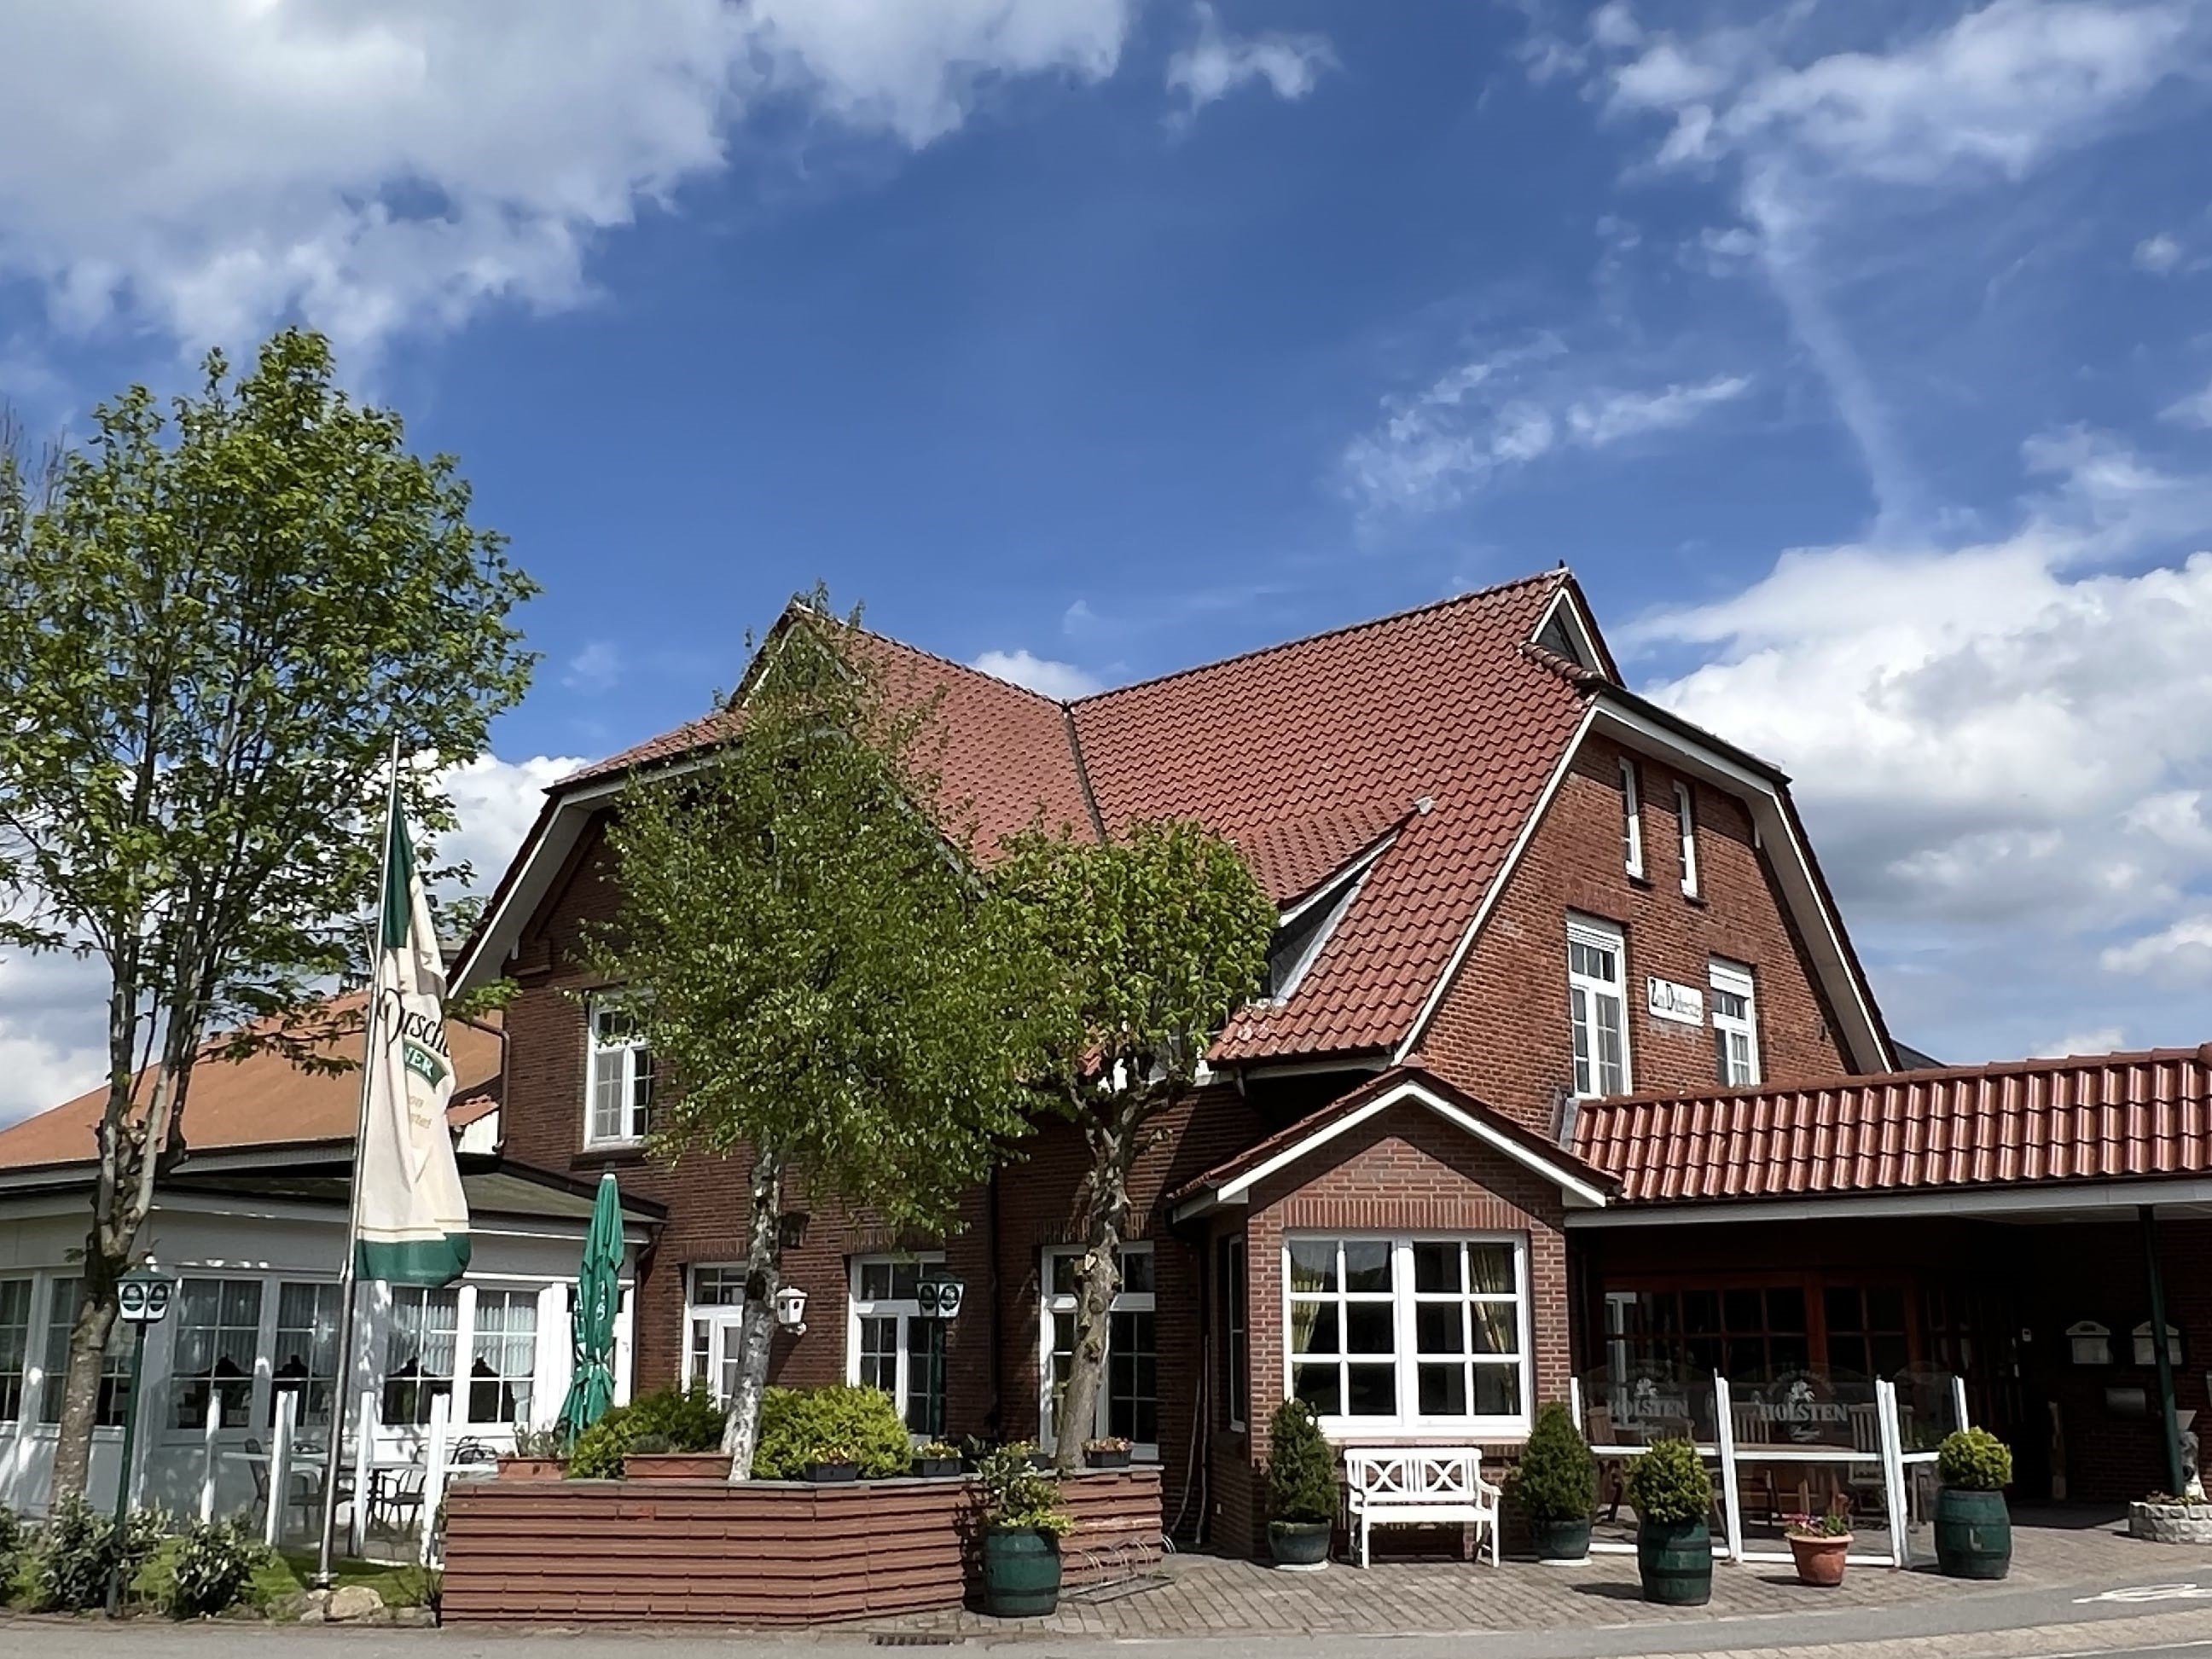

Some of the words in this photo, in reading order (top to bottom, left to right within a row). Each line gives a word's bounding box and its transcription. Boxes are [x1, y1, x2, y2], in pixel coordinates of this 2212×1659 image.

[404, 1045, 433, 1077] NER
[1605, 1399, 1690, 1418] HOLSTEN
[1760, 1403, 1849, 1421] HOLSTEN
